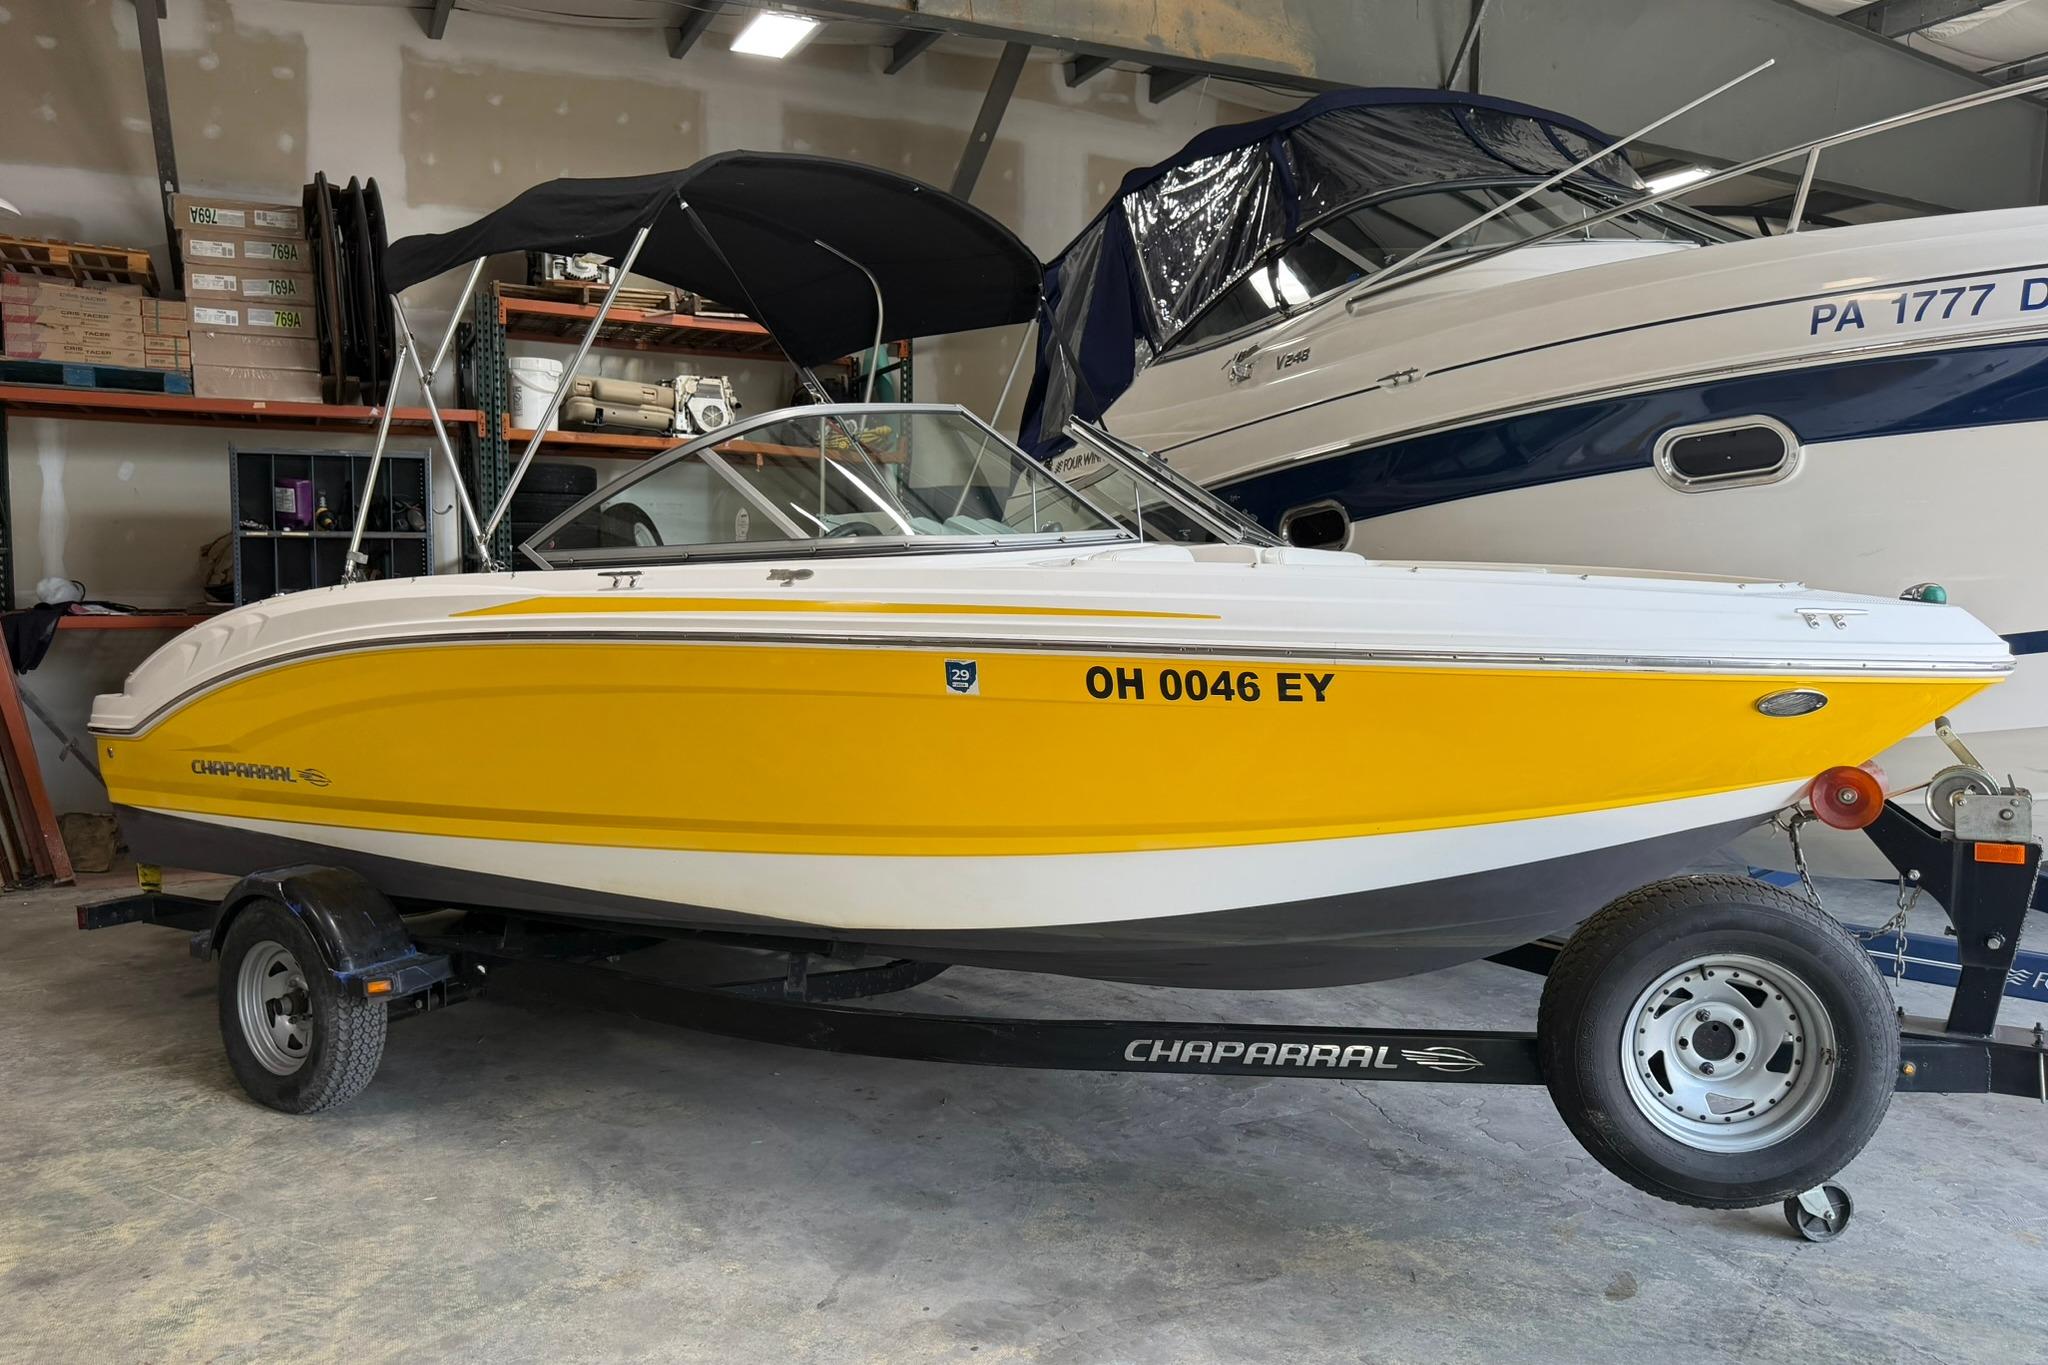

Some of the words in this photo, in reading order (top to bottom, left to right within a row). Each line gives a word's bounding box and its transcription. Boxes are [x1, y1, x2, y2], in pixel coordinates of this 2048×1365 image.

[190, 207, 217, 224] 769A
[271, 244, 298, 260] 769A
[268, 279, 296, 295] 769A
[274, 311, 301, 328] 769A
[1810, 300, 1865, 336] PA
[1891, 283, 1996, 325] 1777
[1277, 346, 1311, 370] V248
[952, 669, 970, 681] 29
[1085, 666, 1144, 700] OH
[1159, 669, 1260, 702] 0046
[1276, 672, 1335, 702] EY
[191, 759, 297, 783] CHAPARRAL
[1124, 1039, 1398, 1069] CHAPARRAL
